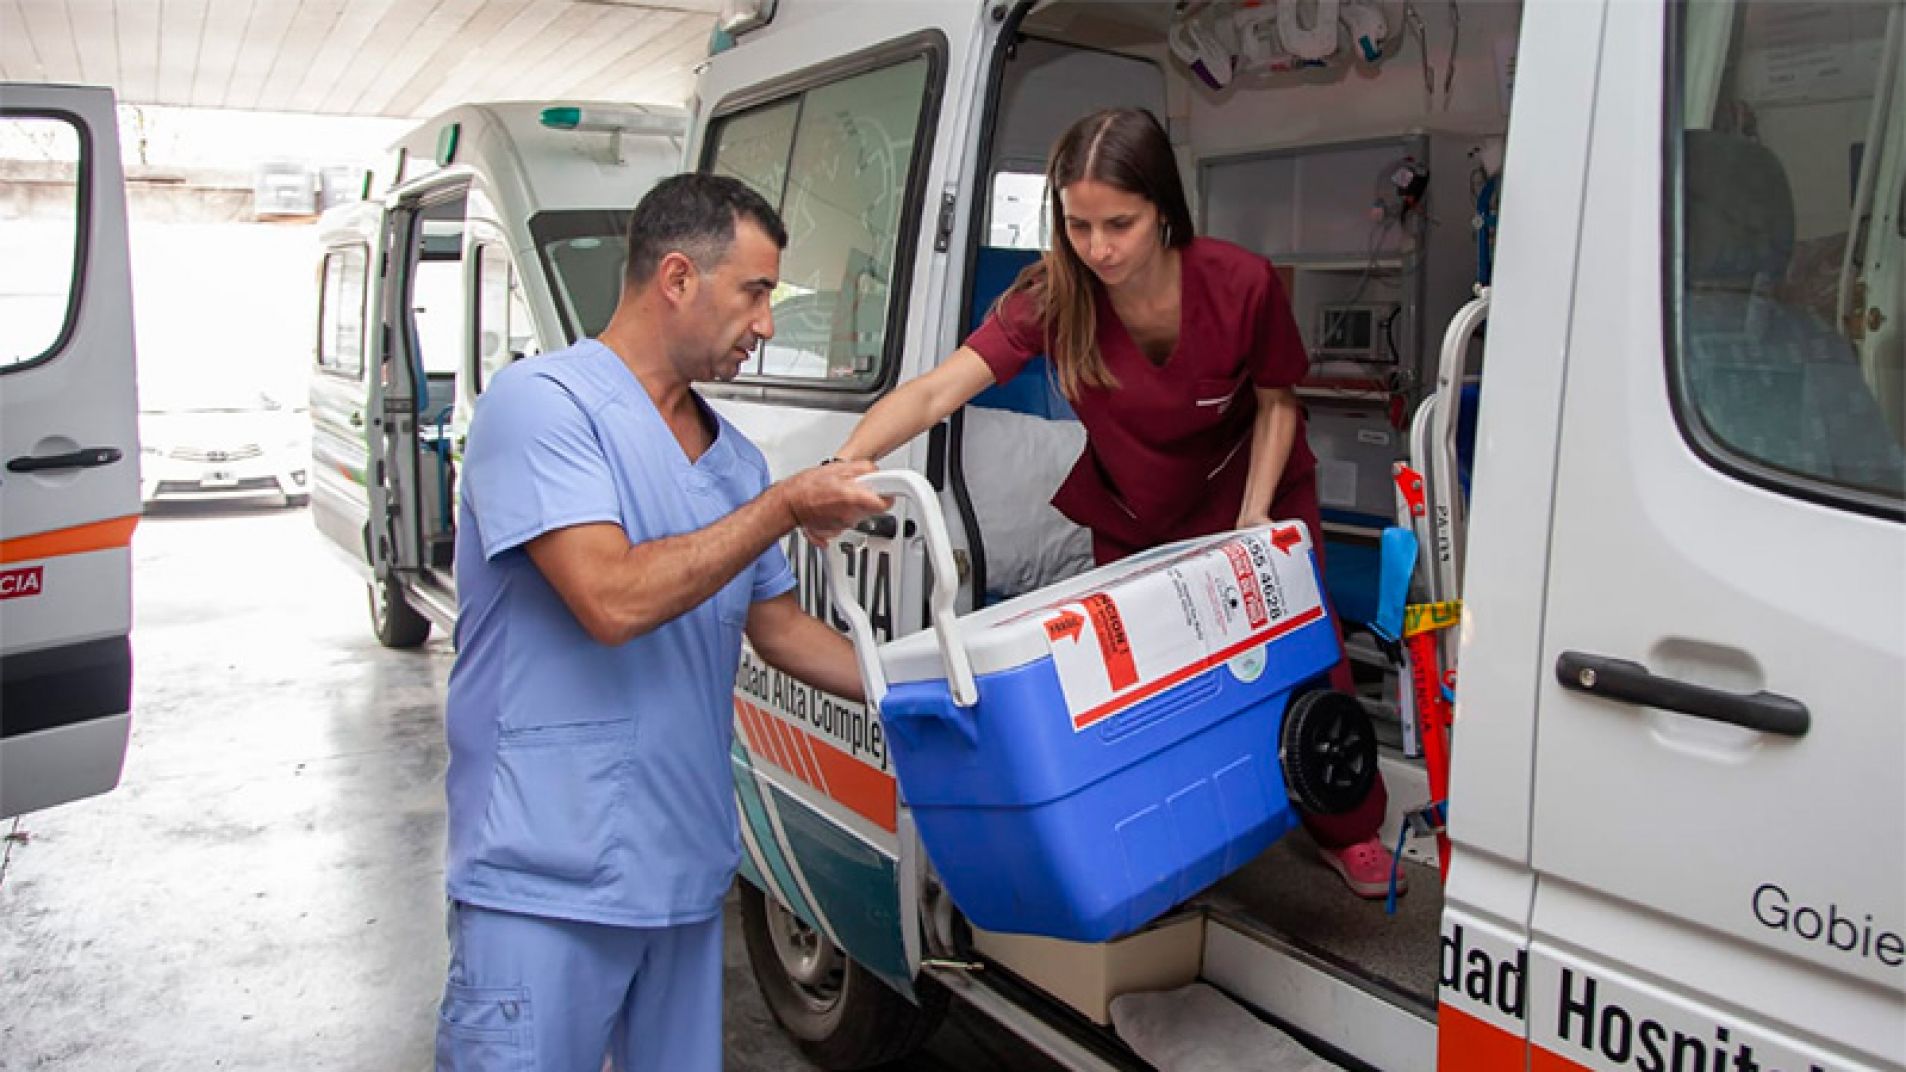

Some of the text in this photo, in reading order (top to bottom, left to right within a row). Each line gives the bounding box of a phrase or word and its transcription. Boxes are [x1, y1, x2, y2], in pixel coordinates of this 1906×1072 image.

[0, 572, 39, 593] CIA
[772, 670, 806, 721] Alta
[1752, 883, 1906, 967] Gobie
[1440, 923, 1528, 1020] dad
